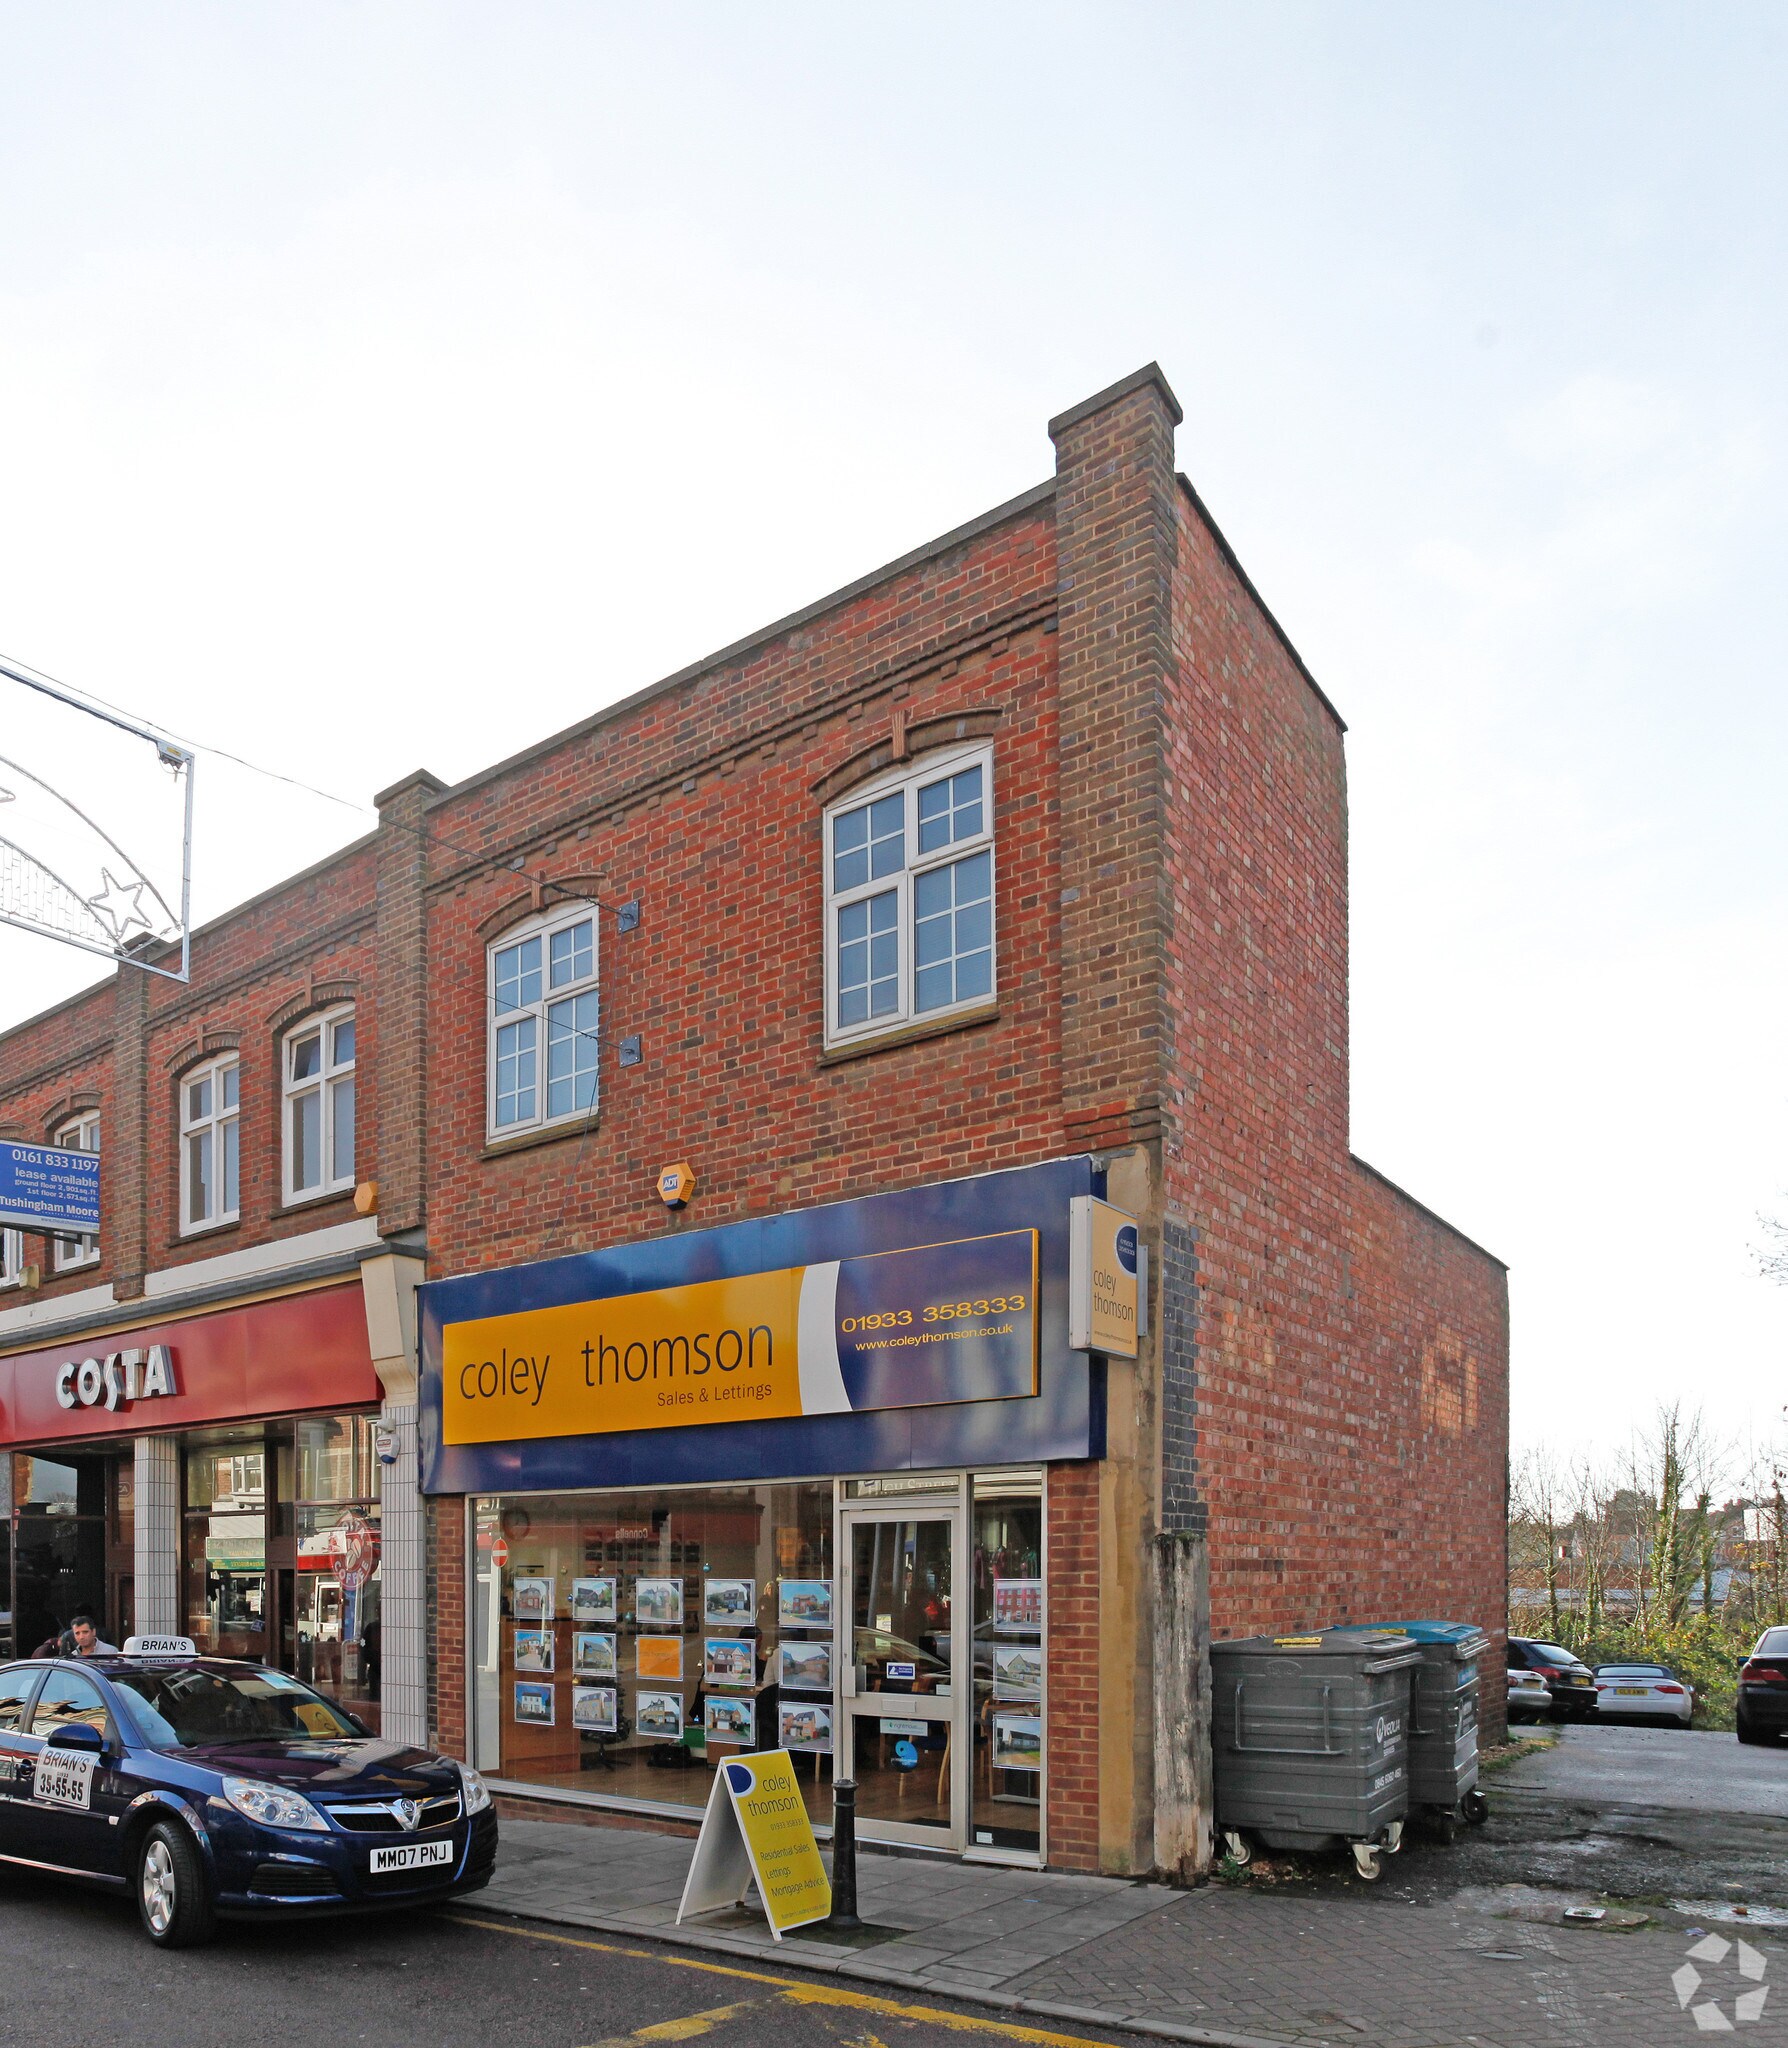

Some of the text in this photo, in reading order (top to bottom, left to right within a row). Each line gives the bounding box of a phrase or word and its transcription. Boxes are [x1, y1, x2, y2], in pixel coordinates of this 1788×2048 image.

[12, 1149, 99, 1173] 0161 833 1197
[15, 1167, 98, 1188] lease available
[15, 1179, 39, 1187] ground
[40, 1182, 56, 1190] floor
[663, 1176, 678, 1190] ADT
[0, 1195, 64, 1212] Tushingham
[66, 1204, 99, 1217] Moore
[1093, 1268, 1117, 1297] coley
[841, 1295, 1026, 1333] 01933 358333
[1093, 1294, 1134, 1322] thomson
[855, 1324, 1013, 1351] www.coleythomson.co.uk
[460, 1324, 773, 1406] coley thomson
[55, 1344, 176, 1412] COSTA
[657, 1383, 772, 1407] Sales & Lettings
[334, 1560, 369, 1584] COFFEE
[141, 1640, 187, 1651] BRIAN'S
[43, 1750, 89, 1773] BRIAN'S
[40, 1773, 84, 1801] 35-55-55
[762, 1774, 791, 1793] coley
[748, 1795, 799, 1816] thomson
[770, 1821, 785, 1831] 01933
[378, 1844, 446, 1868] MM07 PNJ
[760, 1842, 810, 1861] Residential Sales
[765, 1865, 791, 1880] Lettings
[771, 1877, 825, 1898] Mortgage Advice
